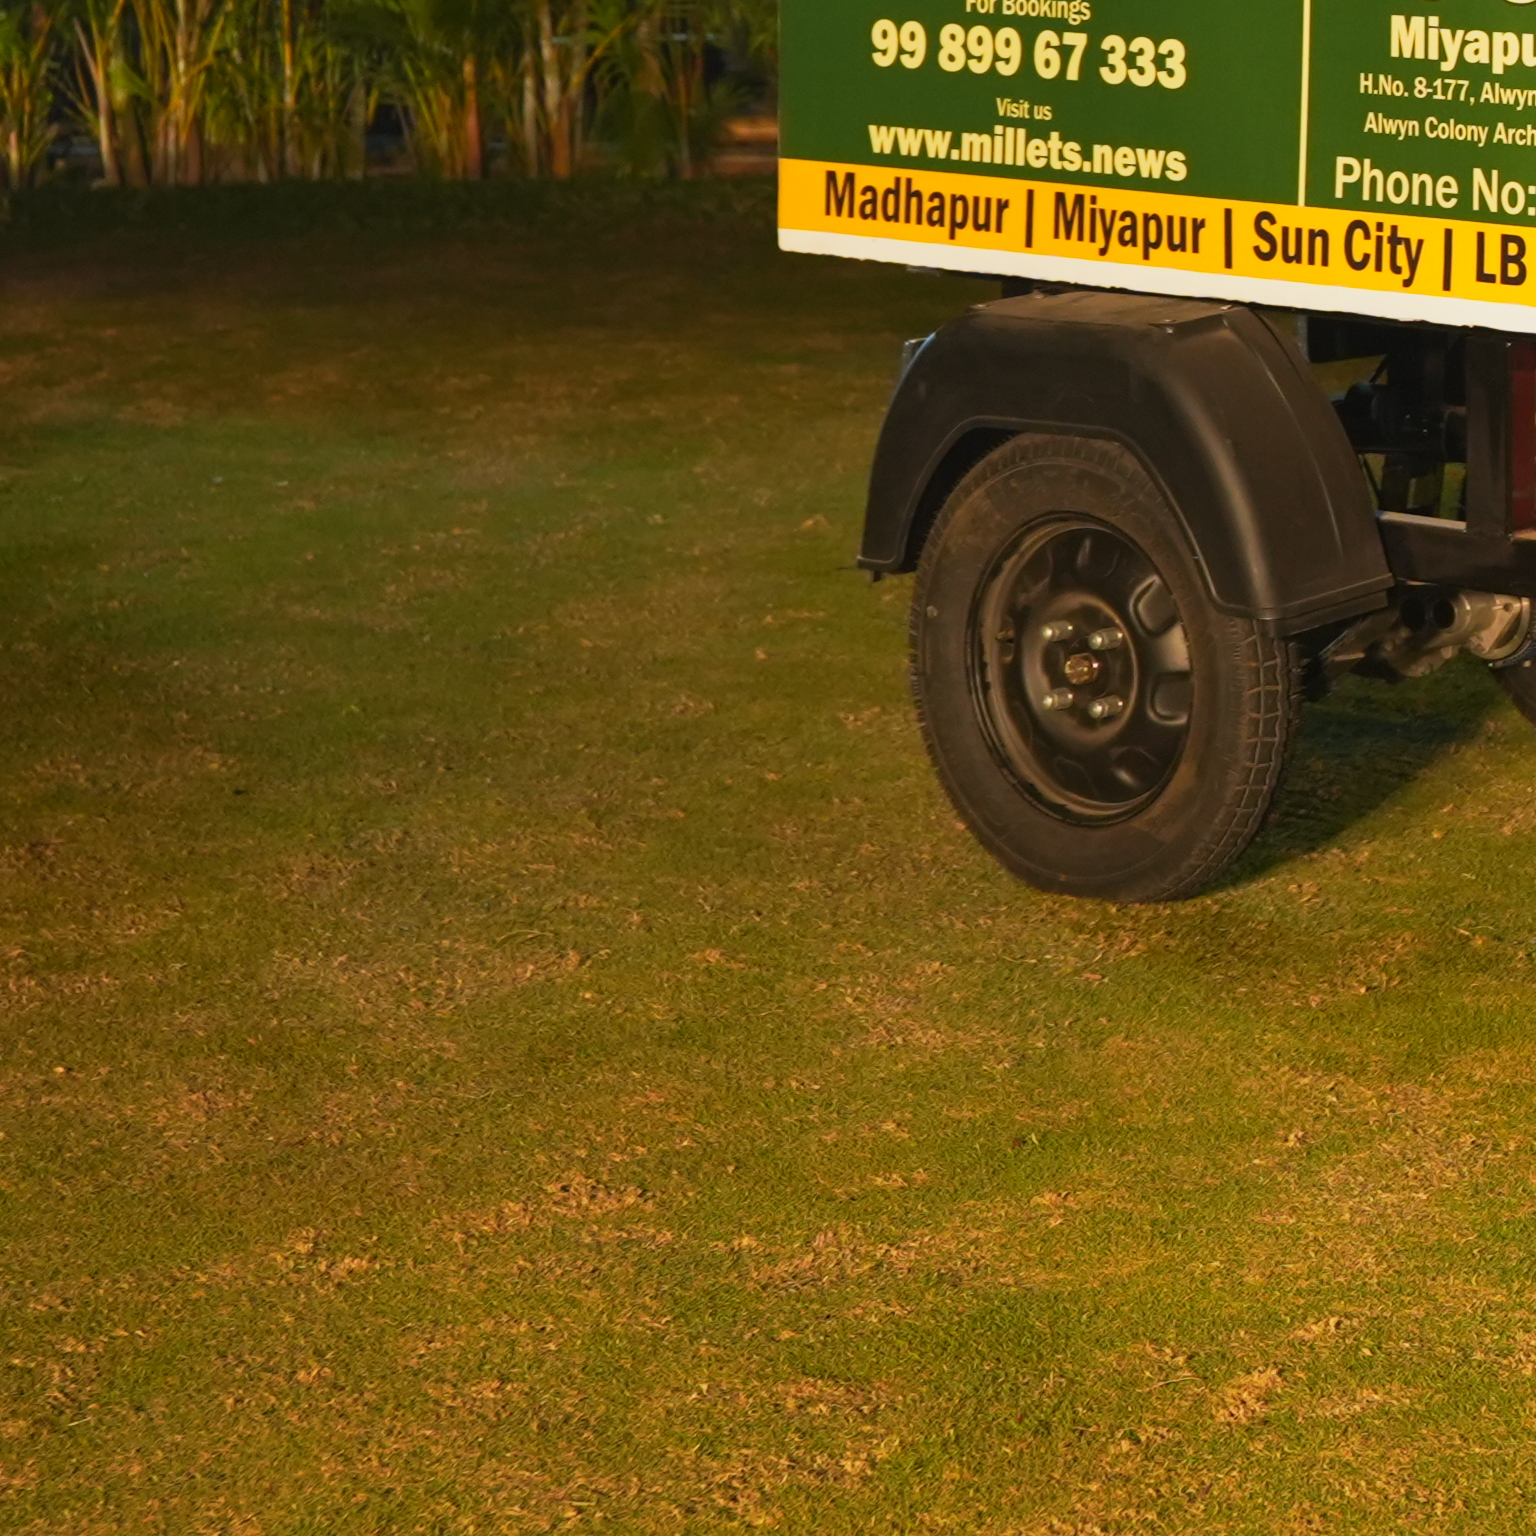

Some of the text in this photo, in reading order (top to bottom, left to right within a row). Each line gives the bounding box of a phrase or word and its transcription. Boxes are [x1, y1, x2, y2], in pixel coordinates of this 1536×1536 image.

[871, 18, 1187, 90] 99 899 67 333
[996, 97, 1053, 121] Visit us
[1359, 72, 1409, 97] H.No.
[1413, 76, 1475, 106] 8-177,
[868, 124, 1188, 182] www.millets.news
[1363, 111, 1420, 141] Alwyn
[1424, 116, 1489, 148] Colony
[1334, 156, 1459, 209] Phone
[1472, 167, 1536, 217] No:
[825, 170, 1009, 240] Madhapur
[1054, 191, 1206, 261] Miyapur
[1253, 210, 1329, 267] Sun
[1344, 219, 1424, 288] City
[1476, 231, 1527, 286] LB
